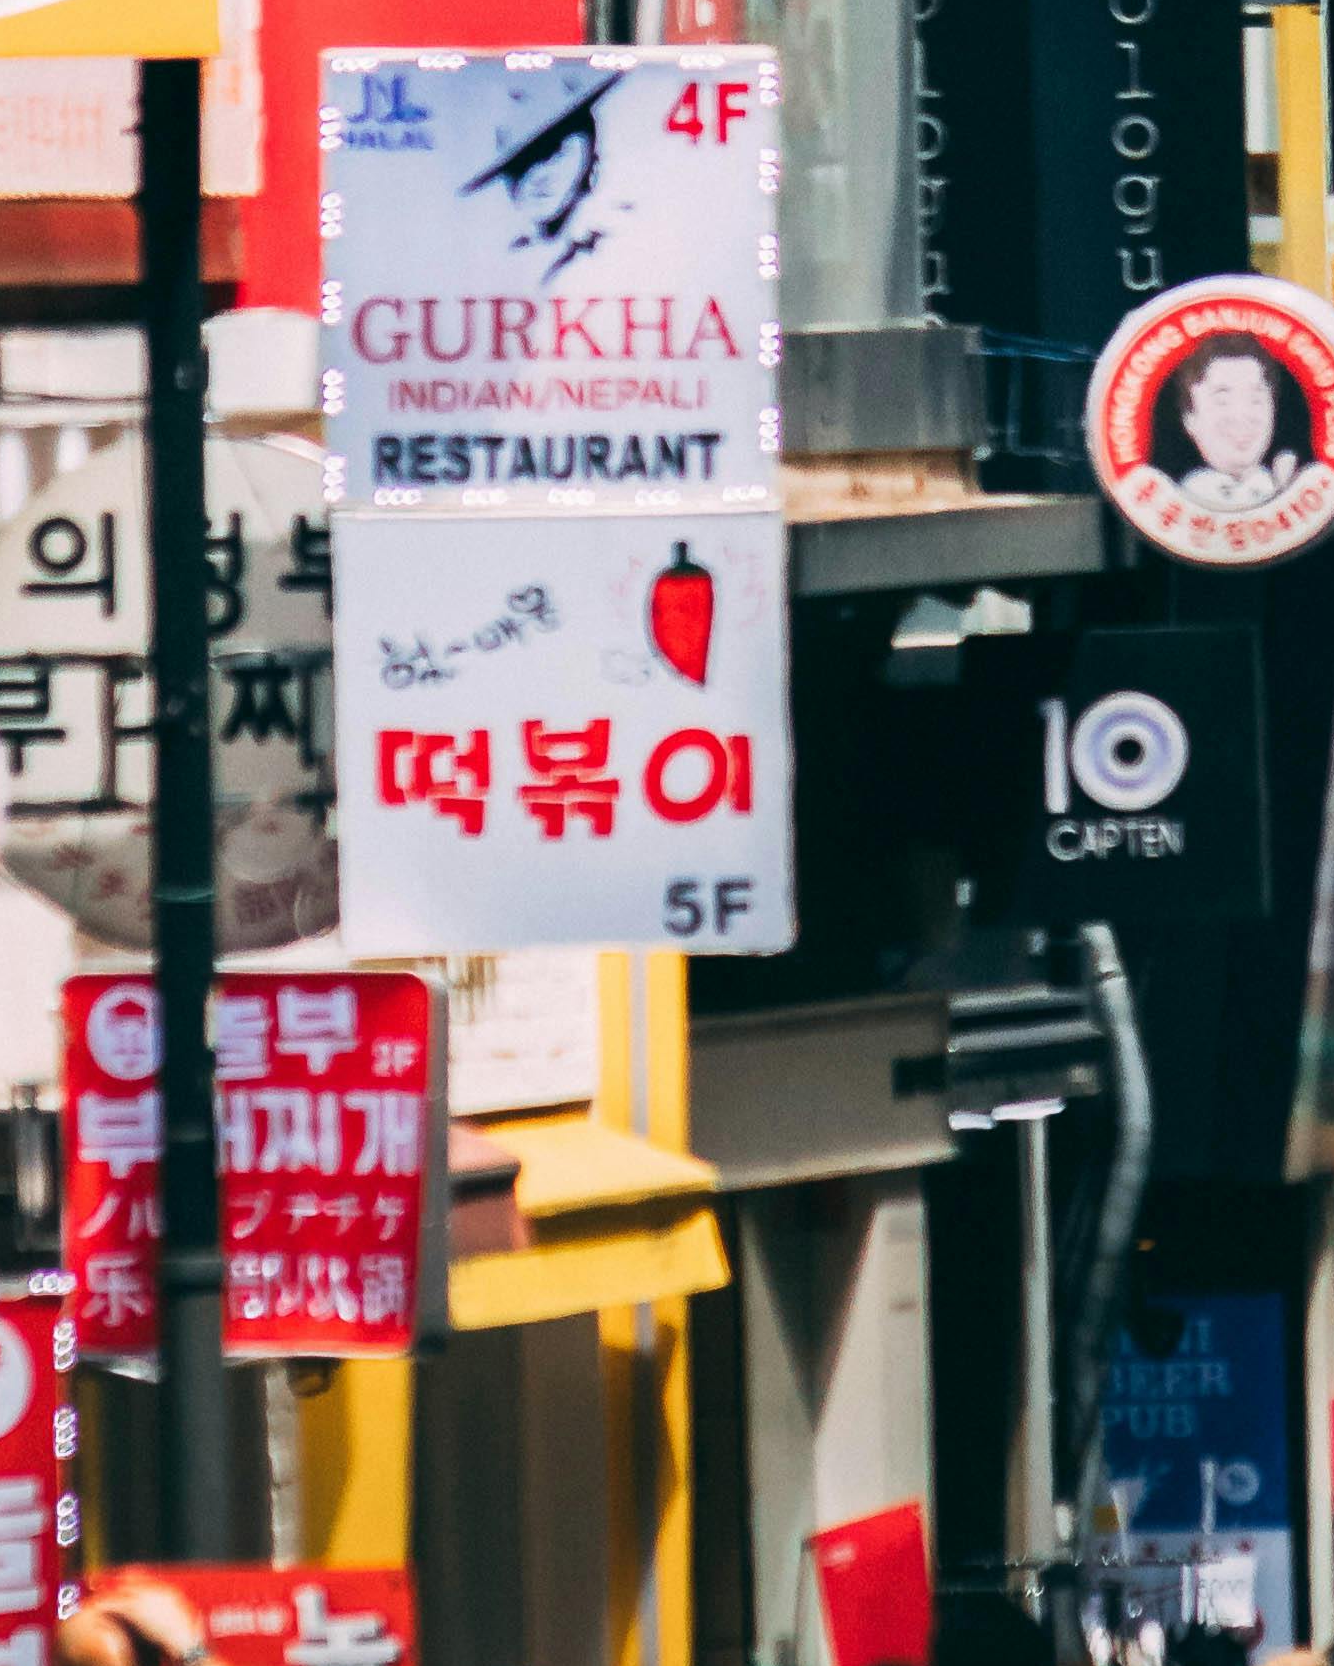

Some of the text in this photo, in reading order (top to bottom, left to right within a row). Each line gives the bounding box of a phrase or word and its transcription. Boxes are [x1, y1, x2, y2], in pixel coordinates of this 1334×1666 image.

[666, 81, 750, 146] 4F
[350, 295, 745, 364] GURKHA
[387, 379, 709, 413] INDIAN/NEPALI
[373, 433, 723, 483] RESTAURANT
[375, 717, 753, 841] 떡볶이
[663, 876, 750, 935] 5F
